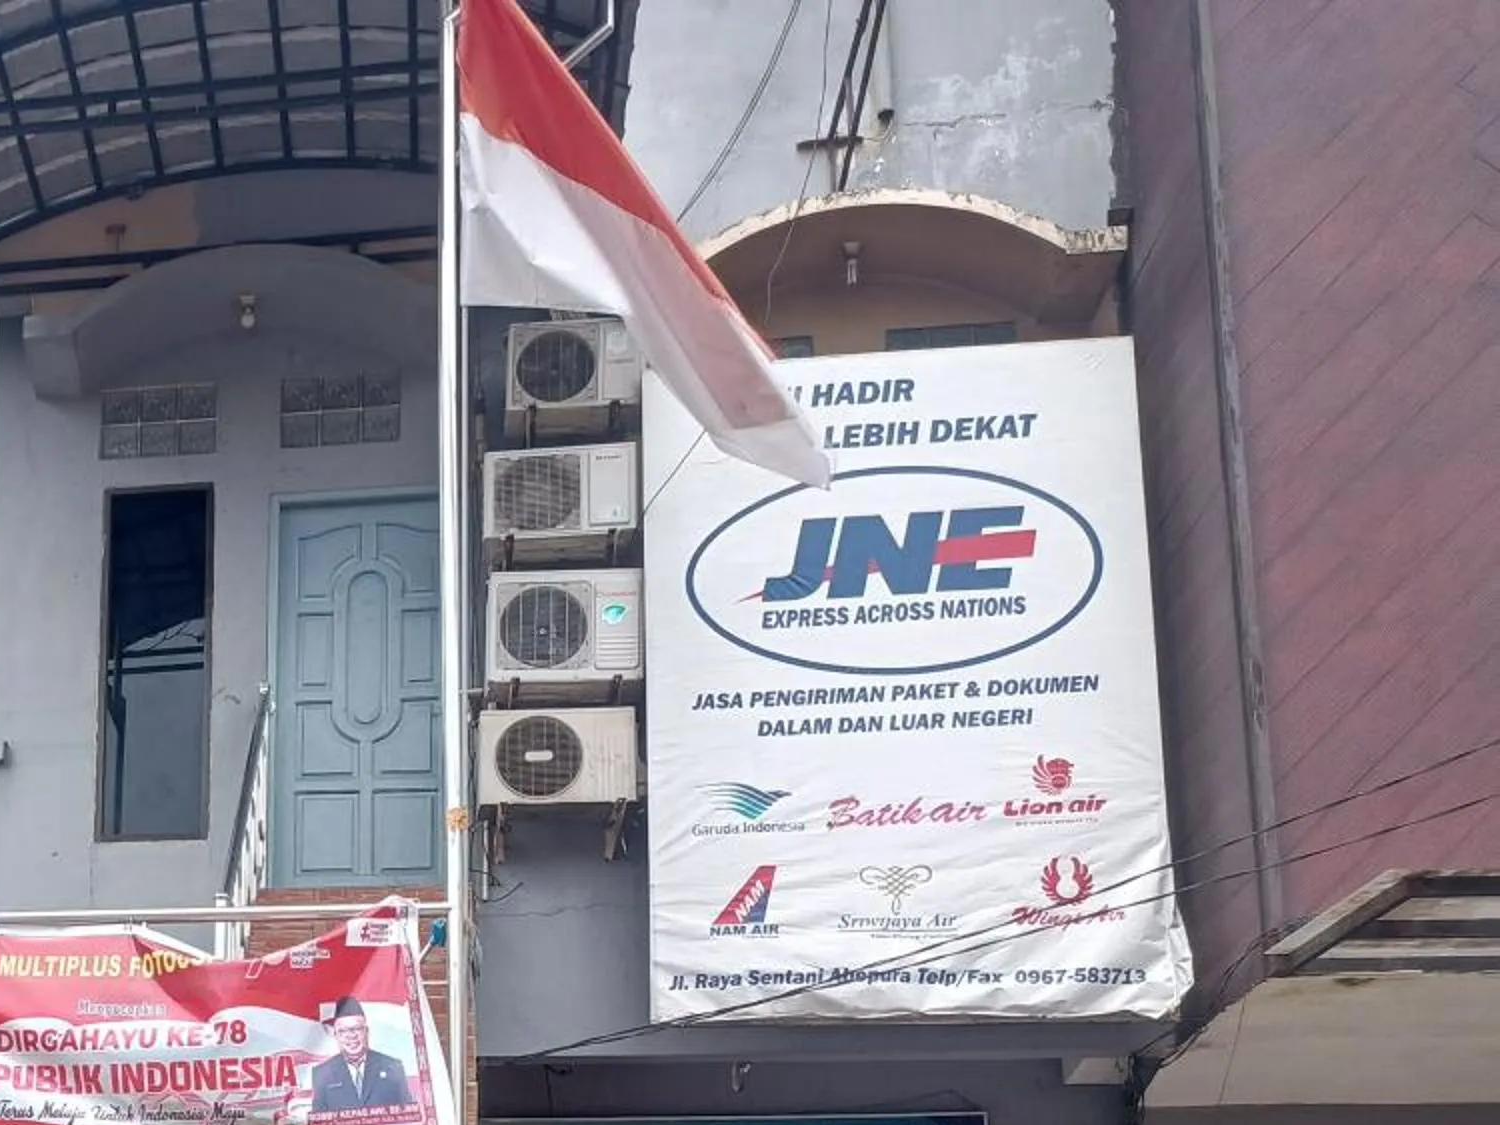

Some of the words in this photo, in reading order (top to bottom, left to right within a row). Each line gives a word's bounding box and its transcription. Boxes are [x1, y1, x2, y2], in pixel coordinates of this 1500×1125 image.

[811, 379, 915, 407] HADIR
[824, 421, 920, 449] LEBIH
[929, 413, 1038, 443] DEKAT
[762, 505, 1036, 602] JNE
[762, 607, 850, 629] EXPRESS
[854, 601, 935, 625] ACROSS
[940, 596, 1027, 621] NATIONS
[691, 693, 744, 711] JASA
[749, 685, 885, 708] PENGIRIMAN
[891, 682, 959, 702] PAKET
[964, 682, 980, 698] &
[987, 674, 1099, 696] DOKUMEN
[757, 718, 832, 737] DALAM
[837, 715, 884, 734] DAN
[889, 712, 946, 732] LUAR
[951, 708, 1034, 729] NEGERI
[826, 795, 924, 831] Batik
[1003, 799, 1063, 817] Lion
[1067, 795, 1108, 813] air
[691, 823, 739, 837] Garuda
[743, 821, 805, 834] Indonesia
[734, 879, 766, 922] NAM
[709, 925, 747, 937] NAM
[750, 924, 780, 936] AIR
[838, 913, 922, 932] Sriwijaya
[926, 914, 957, 928] Air
[668, 975, 689, 991] Jl.
[695, 973, 742, 991] Raya
[747, 968, 823, 986] Sentani
[917, 968, 1003, 987] Telp/Fax
[1015, 967, 1147, 985] 0967-583713
[166, 1019, 247, 1048] KE-78
[110, 1054, 299, 1093] INDONESIA
[137, 1103, 205, 1121] Indonesia
